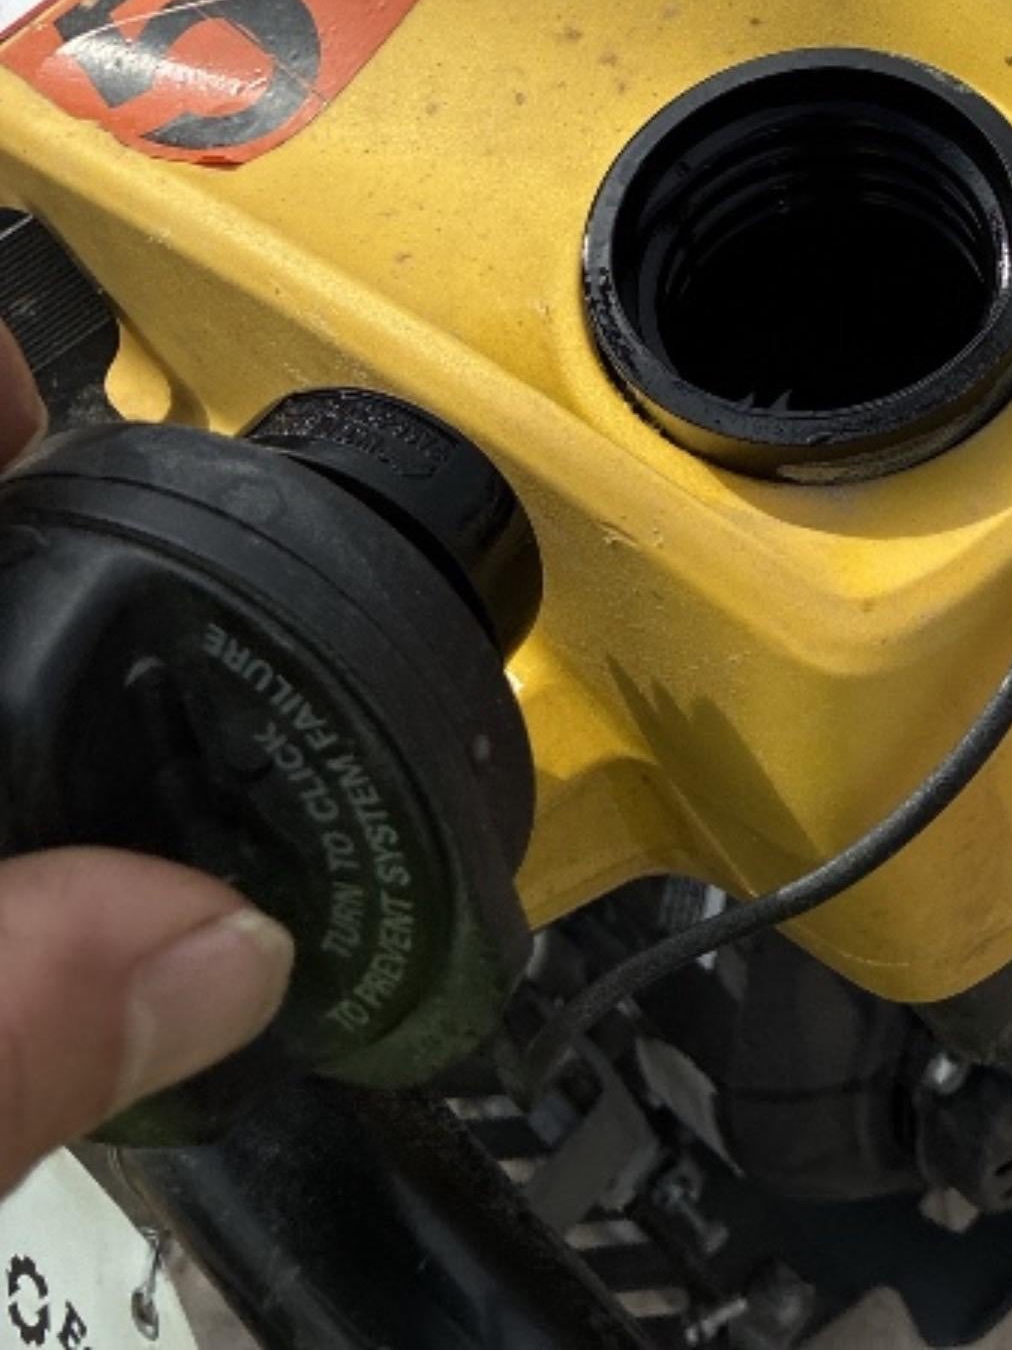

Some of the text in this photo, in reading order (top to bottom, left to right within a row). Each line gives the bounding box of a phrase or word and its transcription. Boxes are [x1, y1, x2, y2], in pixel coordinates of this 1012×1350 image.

[203, 623, 415, 1032] TO PREVENT SYSTEM FAILURE
[253, 721, 365, 957] TURN TO CLICK
